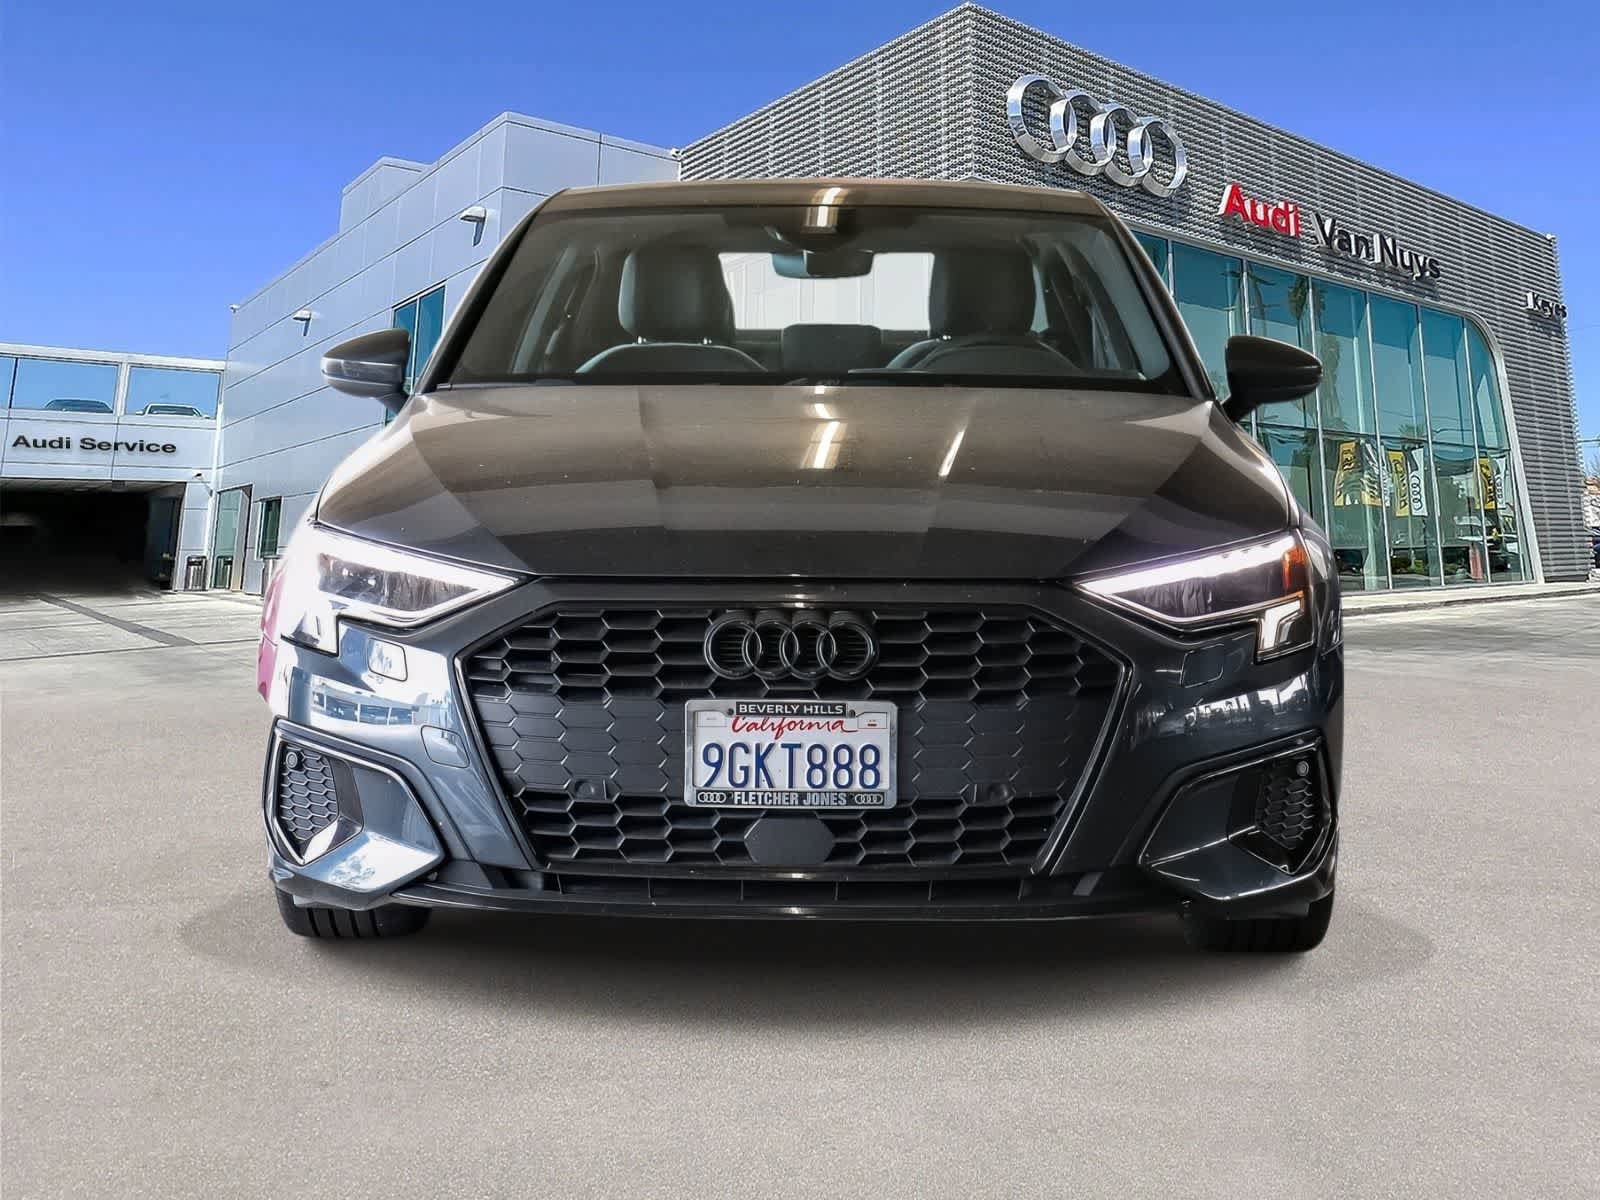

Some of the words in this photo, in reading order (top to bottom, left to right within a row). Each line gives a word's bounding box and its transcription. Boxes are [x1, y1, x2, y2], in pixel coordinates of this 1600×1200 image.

[1218, 183, 1302, 237] Audi
[1311, 212, 1371, 259] Van
[1372, 233, 1441, 280] Nuys
[12, 435, 71, 449] Audi
[79, 438, 177, 453] Service
[738, 704, 798, 714] BEVERLY
[803, 704, 844, 714] HILLS
[731, 716, 858, 740] California
[702, 742, 880, 789] 9GKT888
[733, 791, 799, 805] FLETCHER
[803, 792, 847, 805] JONES
